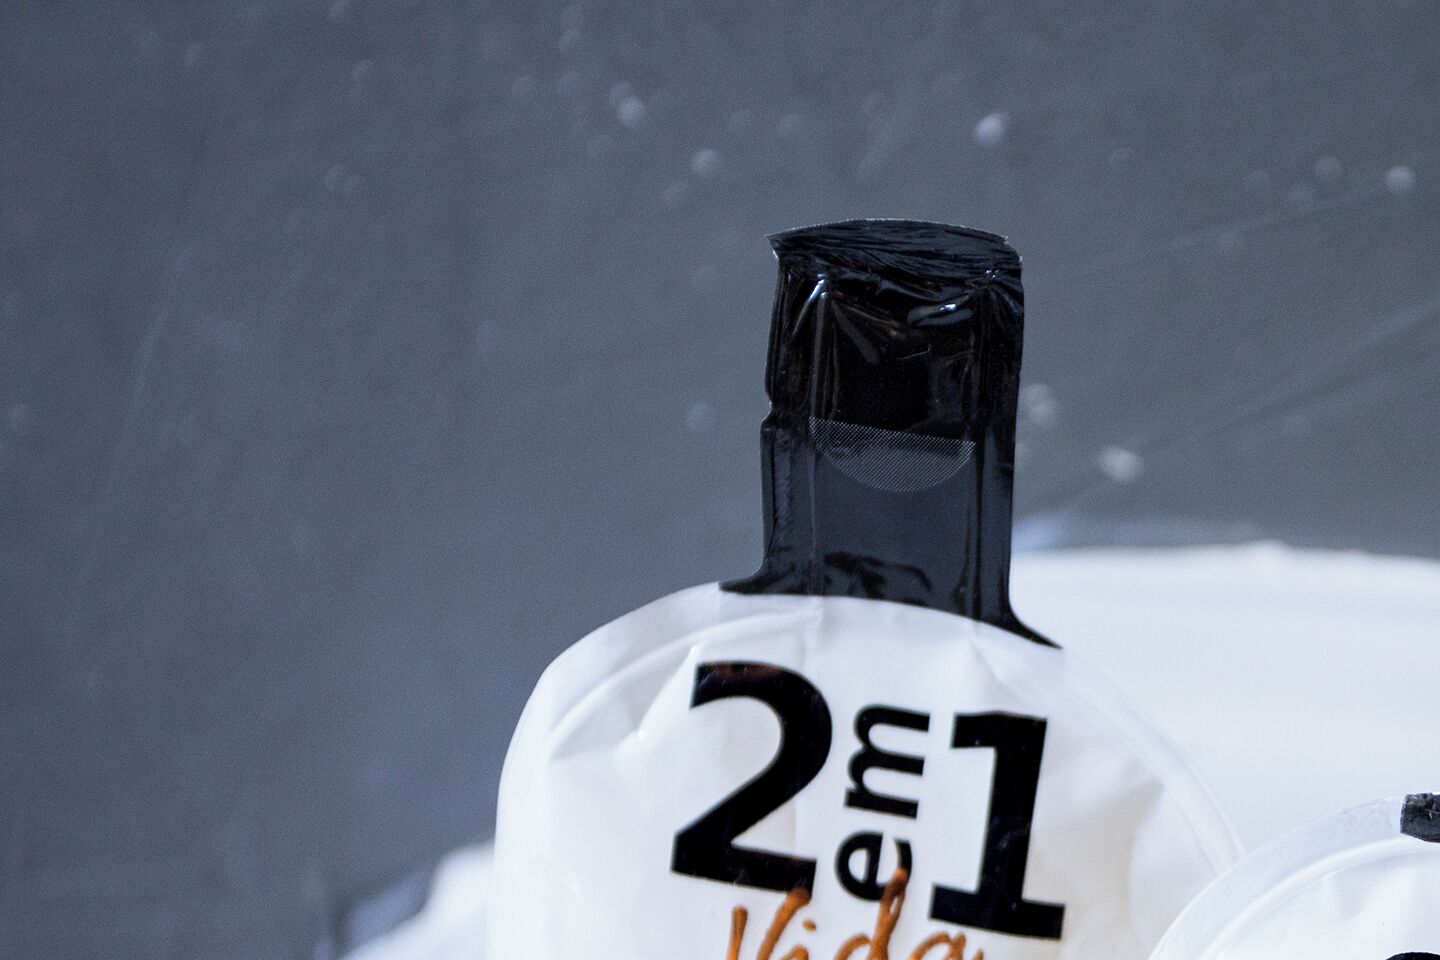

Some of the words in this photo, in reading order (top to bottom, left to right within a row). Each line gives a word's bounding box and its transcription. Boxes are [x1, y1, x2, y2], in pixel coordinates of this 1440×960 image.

[671, 660, 833, 896] 2
[834, 704, 930, 902] em
[928, 711, 1066, 940] 1
